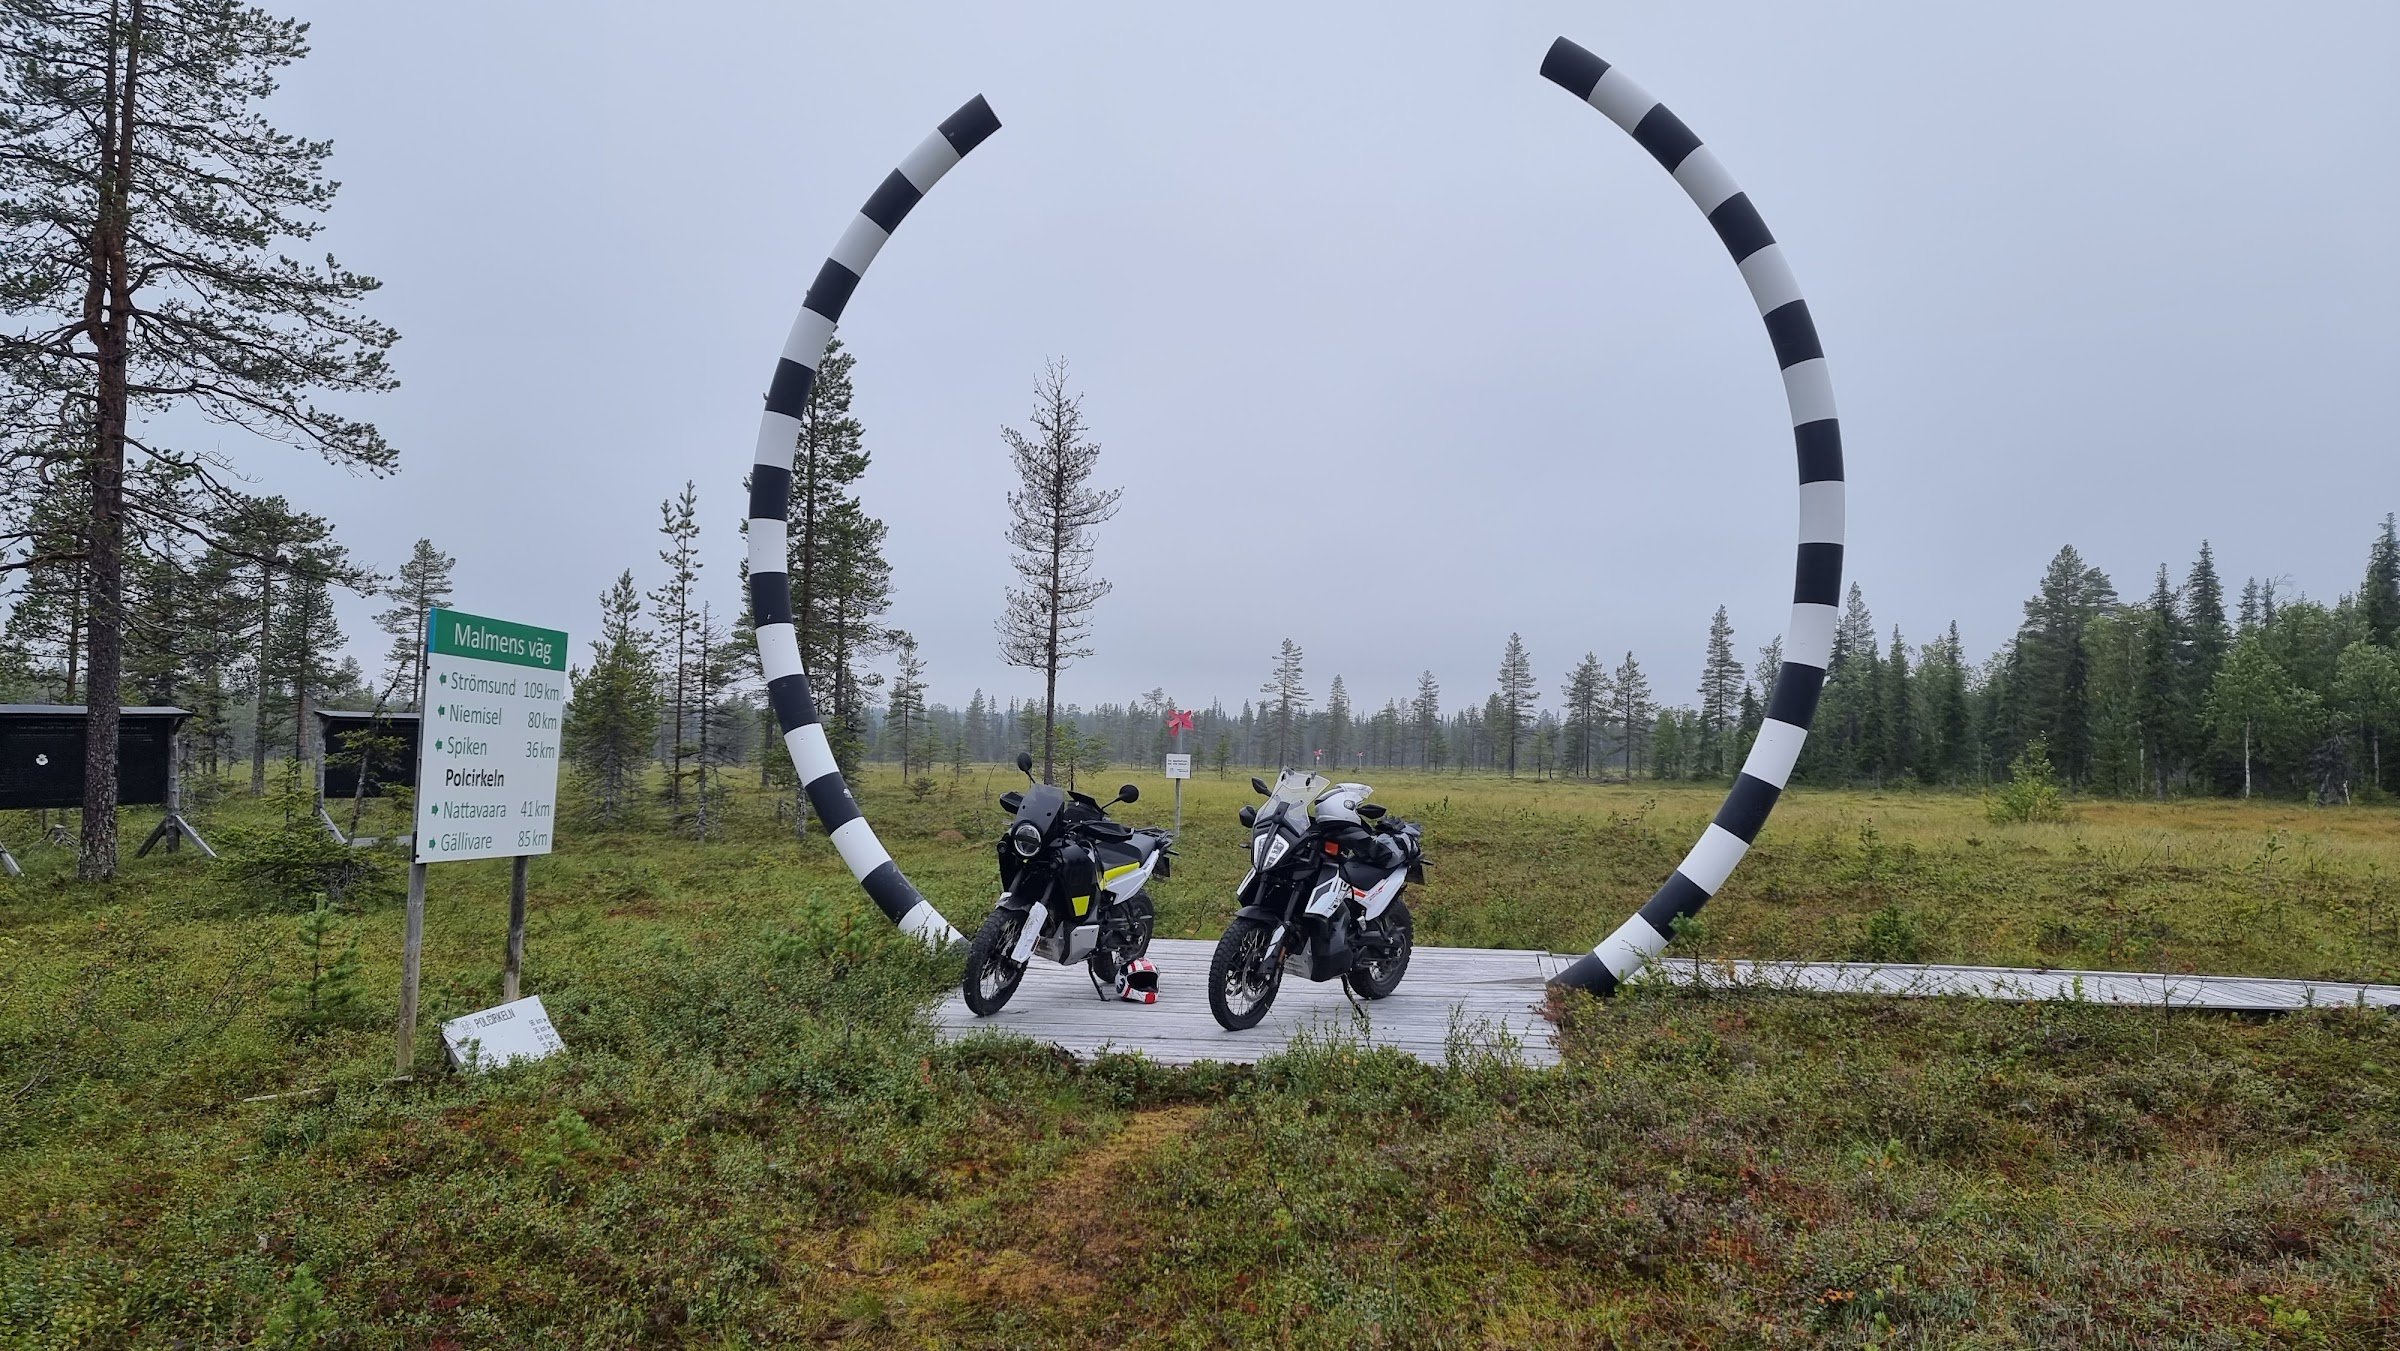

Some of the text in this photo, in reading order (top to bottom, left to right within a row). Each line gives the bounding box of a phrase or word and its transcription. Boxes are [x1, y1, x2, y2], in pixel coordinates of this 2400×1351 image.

[454, 622, 552, 665] Malmens väg
[451, 671, 559, 701] Strömsund 109 km
[449, 704, 557, 730] Niemisel 80 km
[447, 736, 555, 759] Spiken 36 km
[445, 767, 504, 787] Polcirkeln
[443, 799, 550, 819] Nattavaara 41 km
[440, 828, 548, 852] Gällivare 85 km
